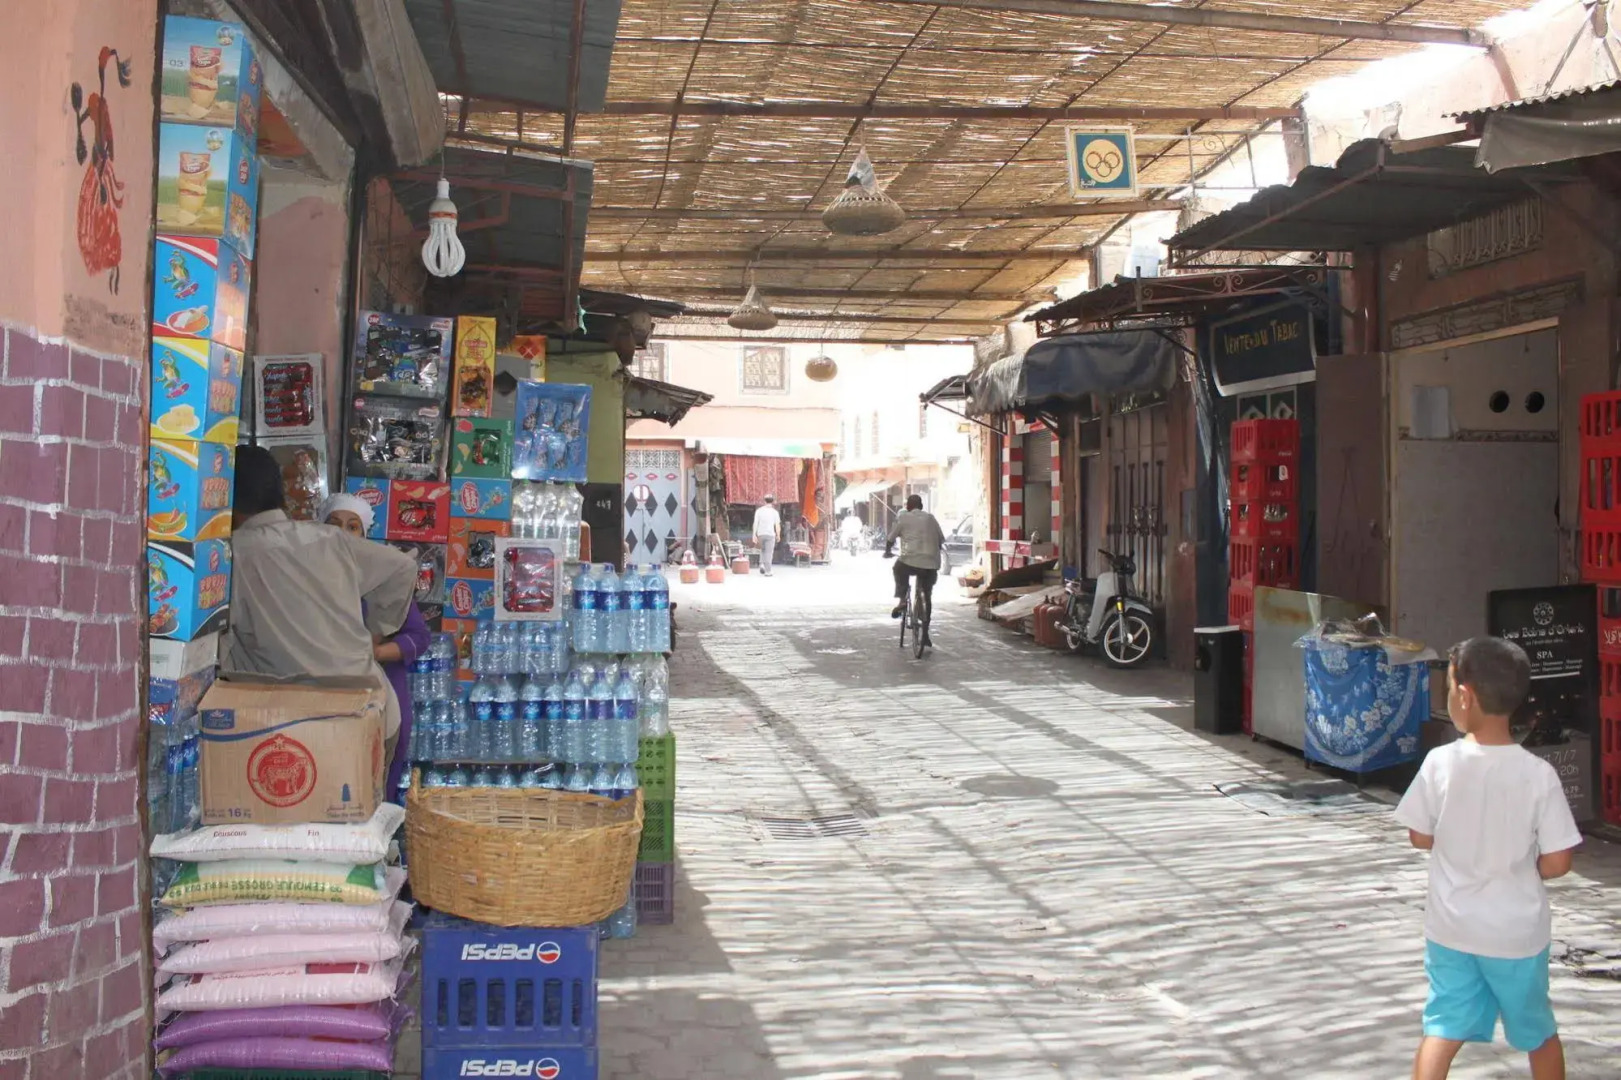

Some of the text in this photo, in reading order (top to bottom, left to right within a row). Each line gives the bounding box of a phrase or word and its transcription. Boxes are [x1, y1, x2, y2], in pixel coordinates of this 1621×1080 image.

[1536, 649, 1554, 659] SPA
[228, 807, 242, 818] 16
[307, 829, 320, 837] Fin
[231, 880, 274, 892] GROSSE
[461, 943, 534, 961] PEPSI
[460, 1060, 534, 1078] PEPSI
